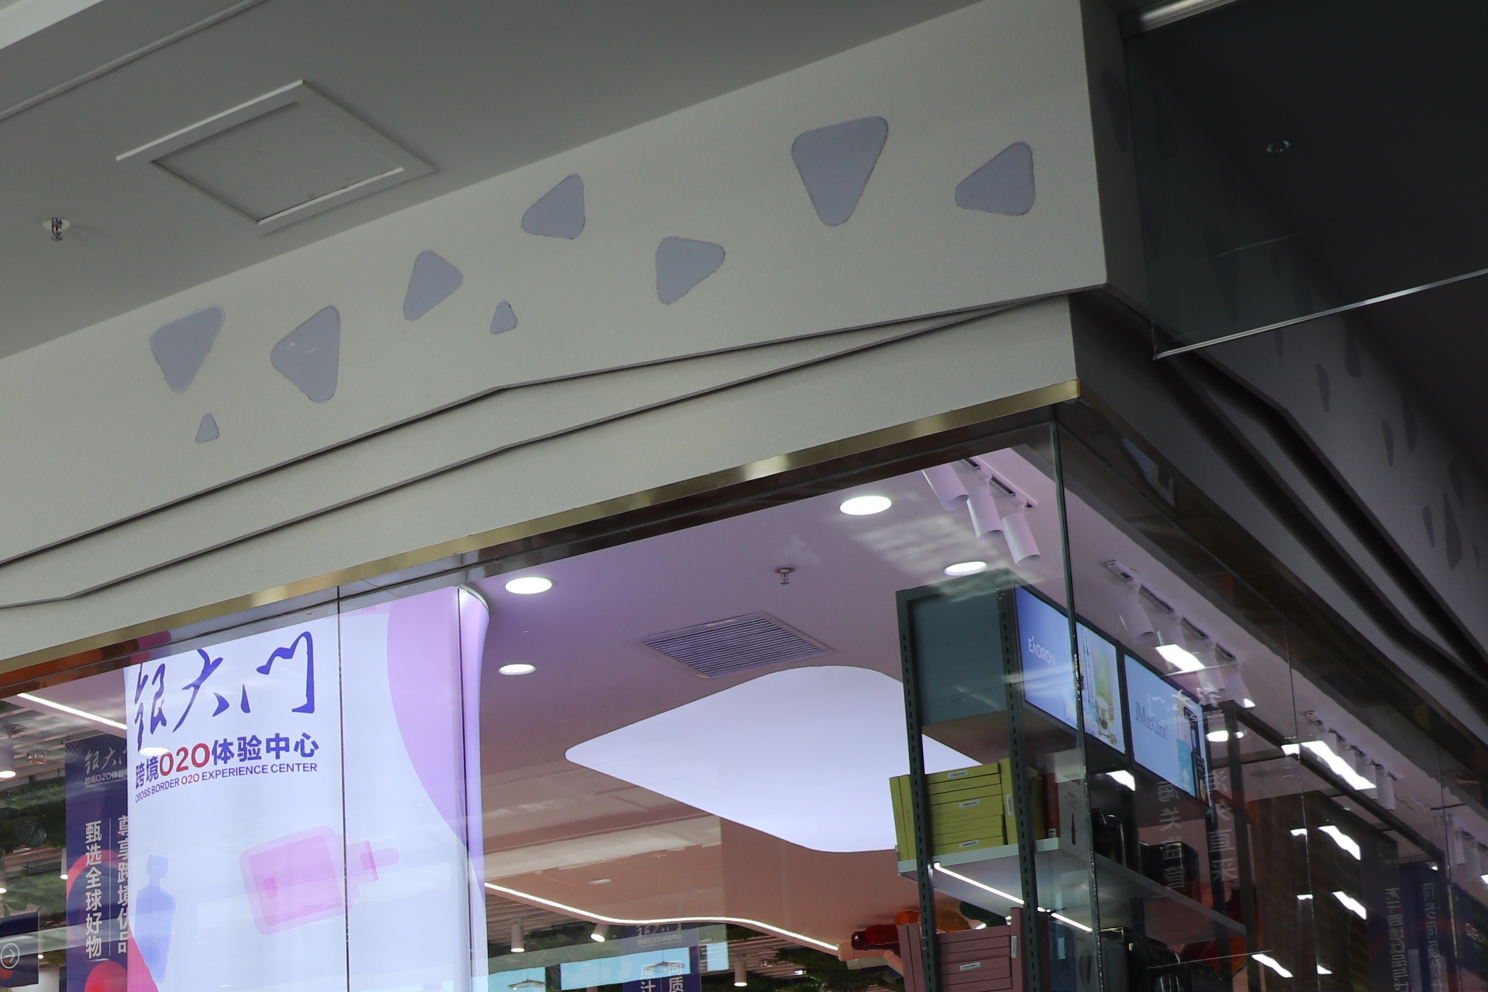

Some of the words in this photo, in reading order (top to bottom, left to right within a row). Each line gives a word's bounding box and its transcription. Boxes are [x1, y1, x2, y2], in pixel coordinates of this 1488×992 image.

[134, 732, 320, 790] 跨境O2O体验中心
[134, 786, 151, 804] CROSS
[151, 777, 180, 796] BORDER
[201, 766, 269, 781] EXPERIENCE
[270, 762, 319, 774] CENTER
[85, 820, 102, 959] 甄选全球好物
